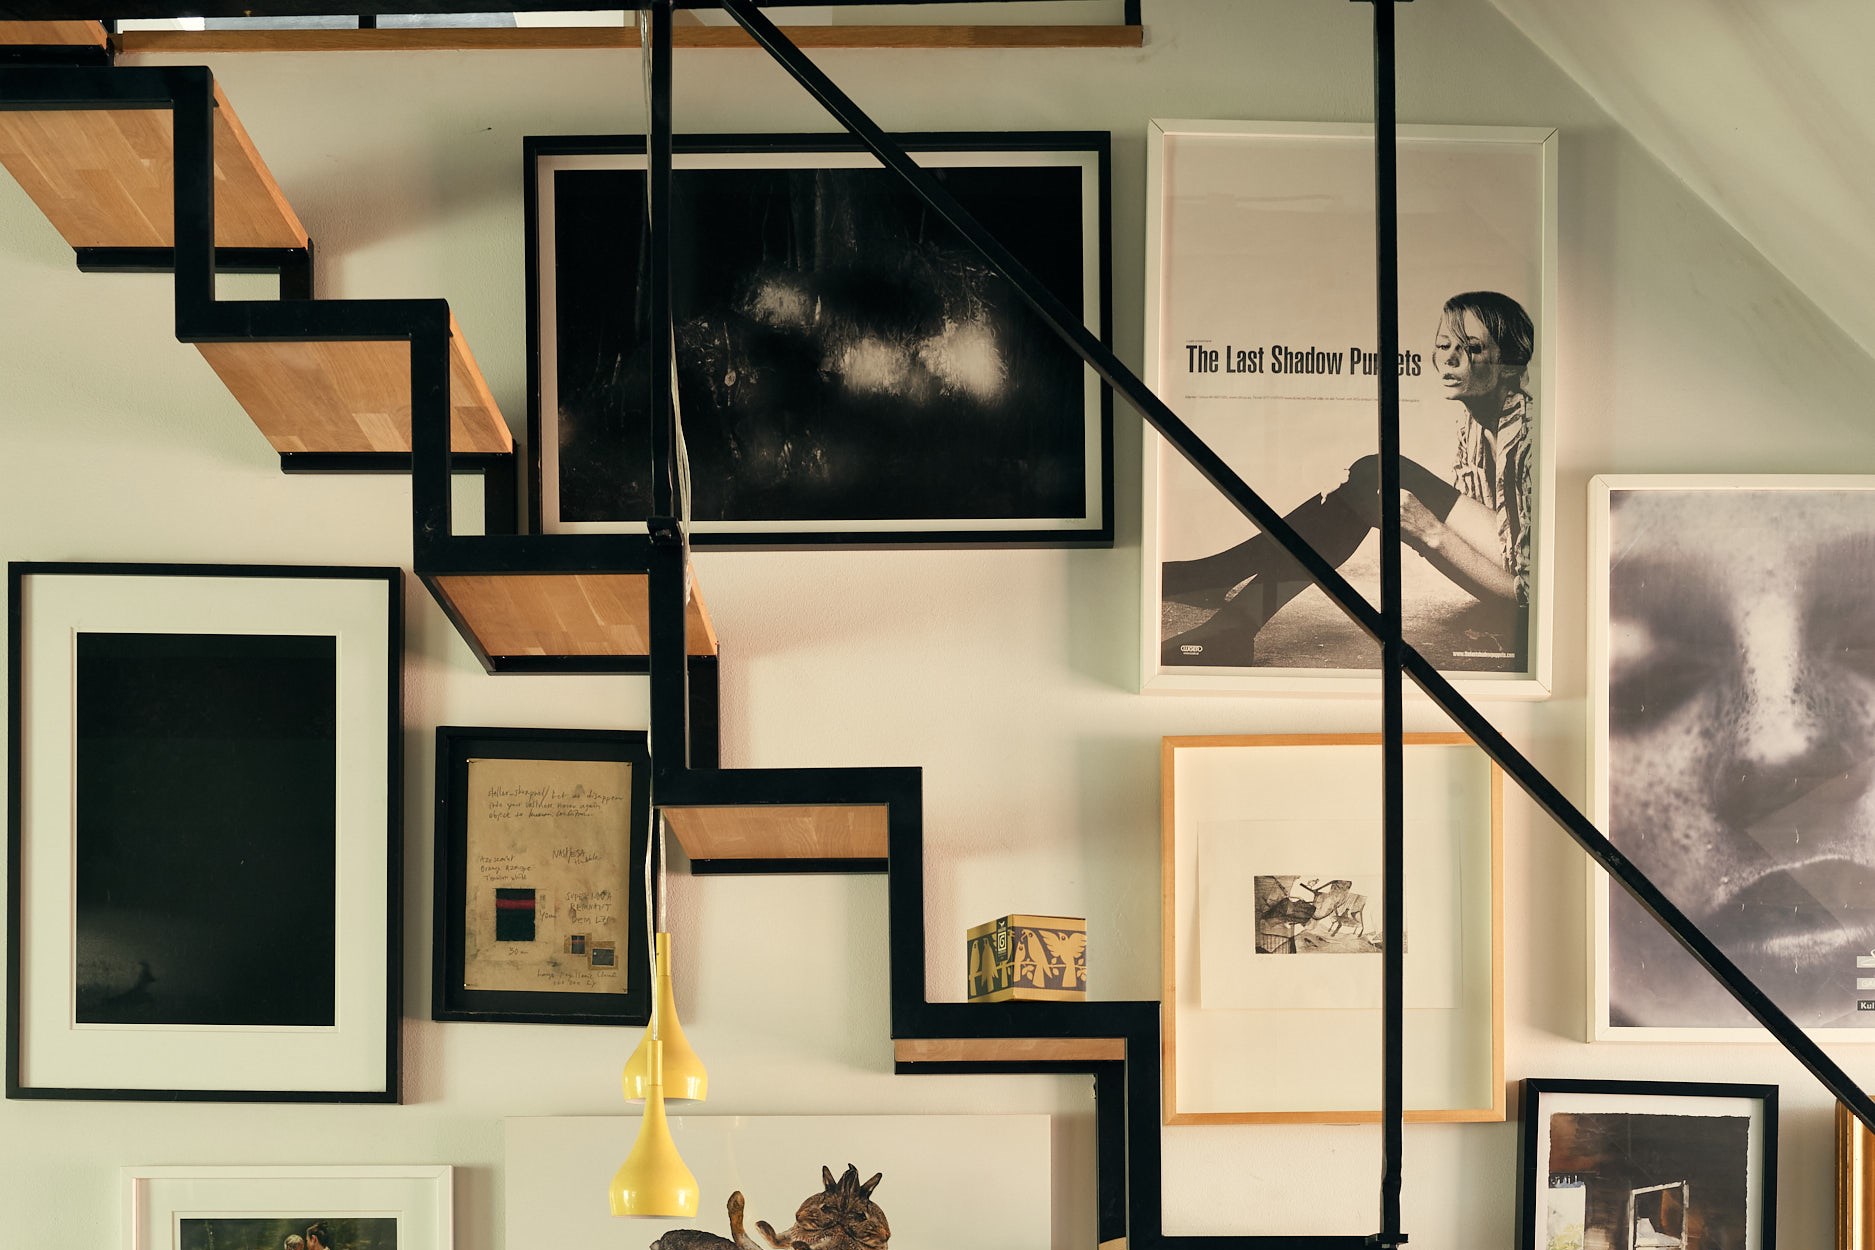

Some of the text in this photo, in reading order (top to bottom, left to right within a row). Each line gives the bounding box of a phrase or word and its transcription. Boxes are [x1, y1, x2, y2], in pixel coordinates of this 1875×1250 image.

[1186, 345, 1422, 377] The Last Shadow Puets
